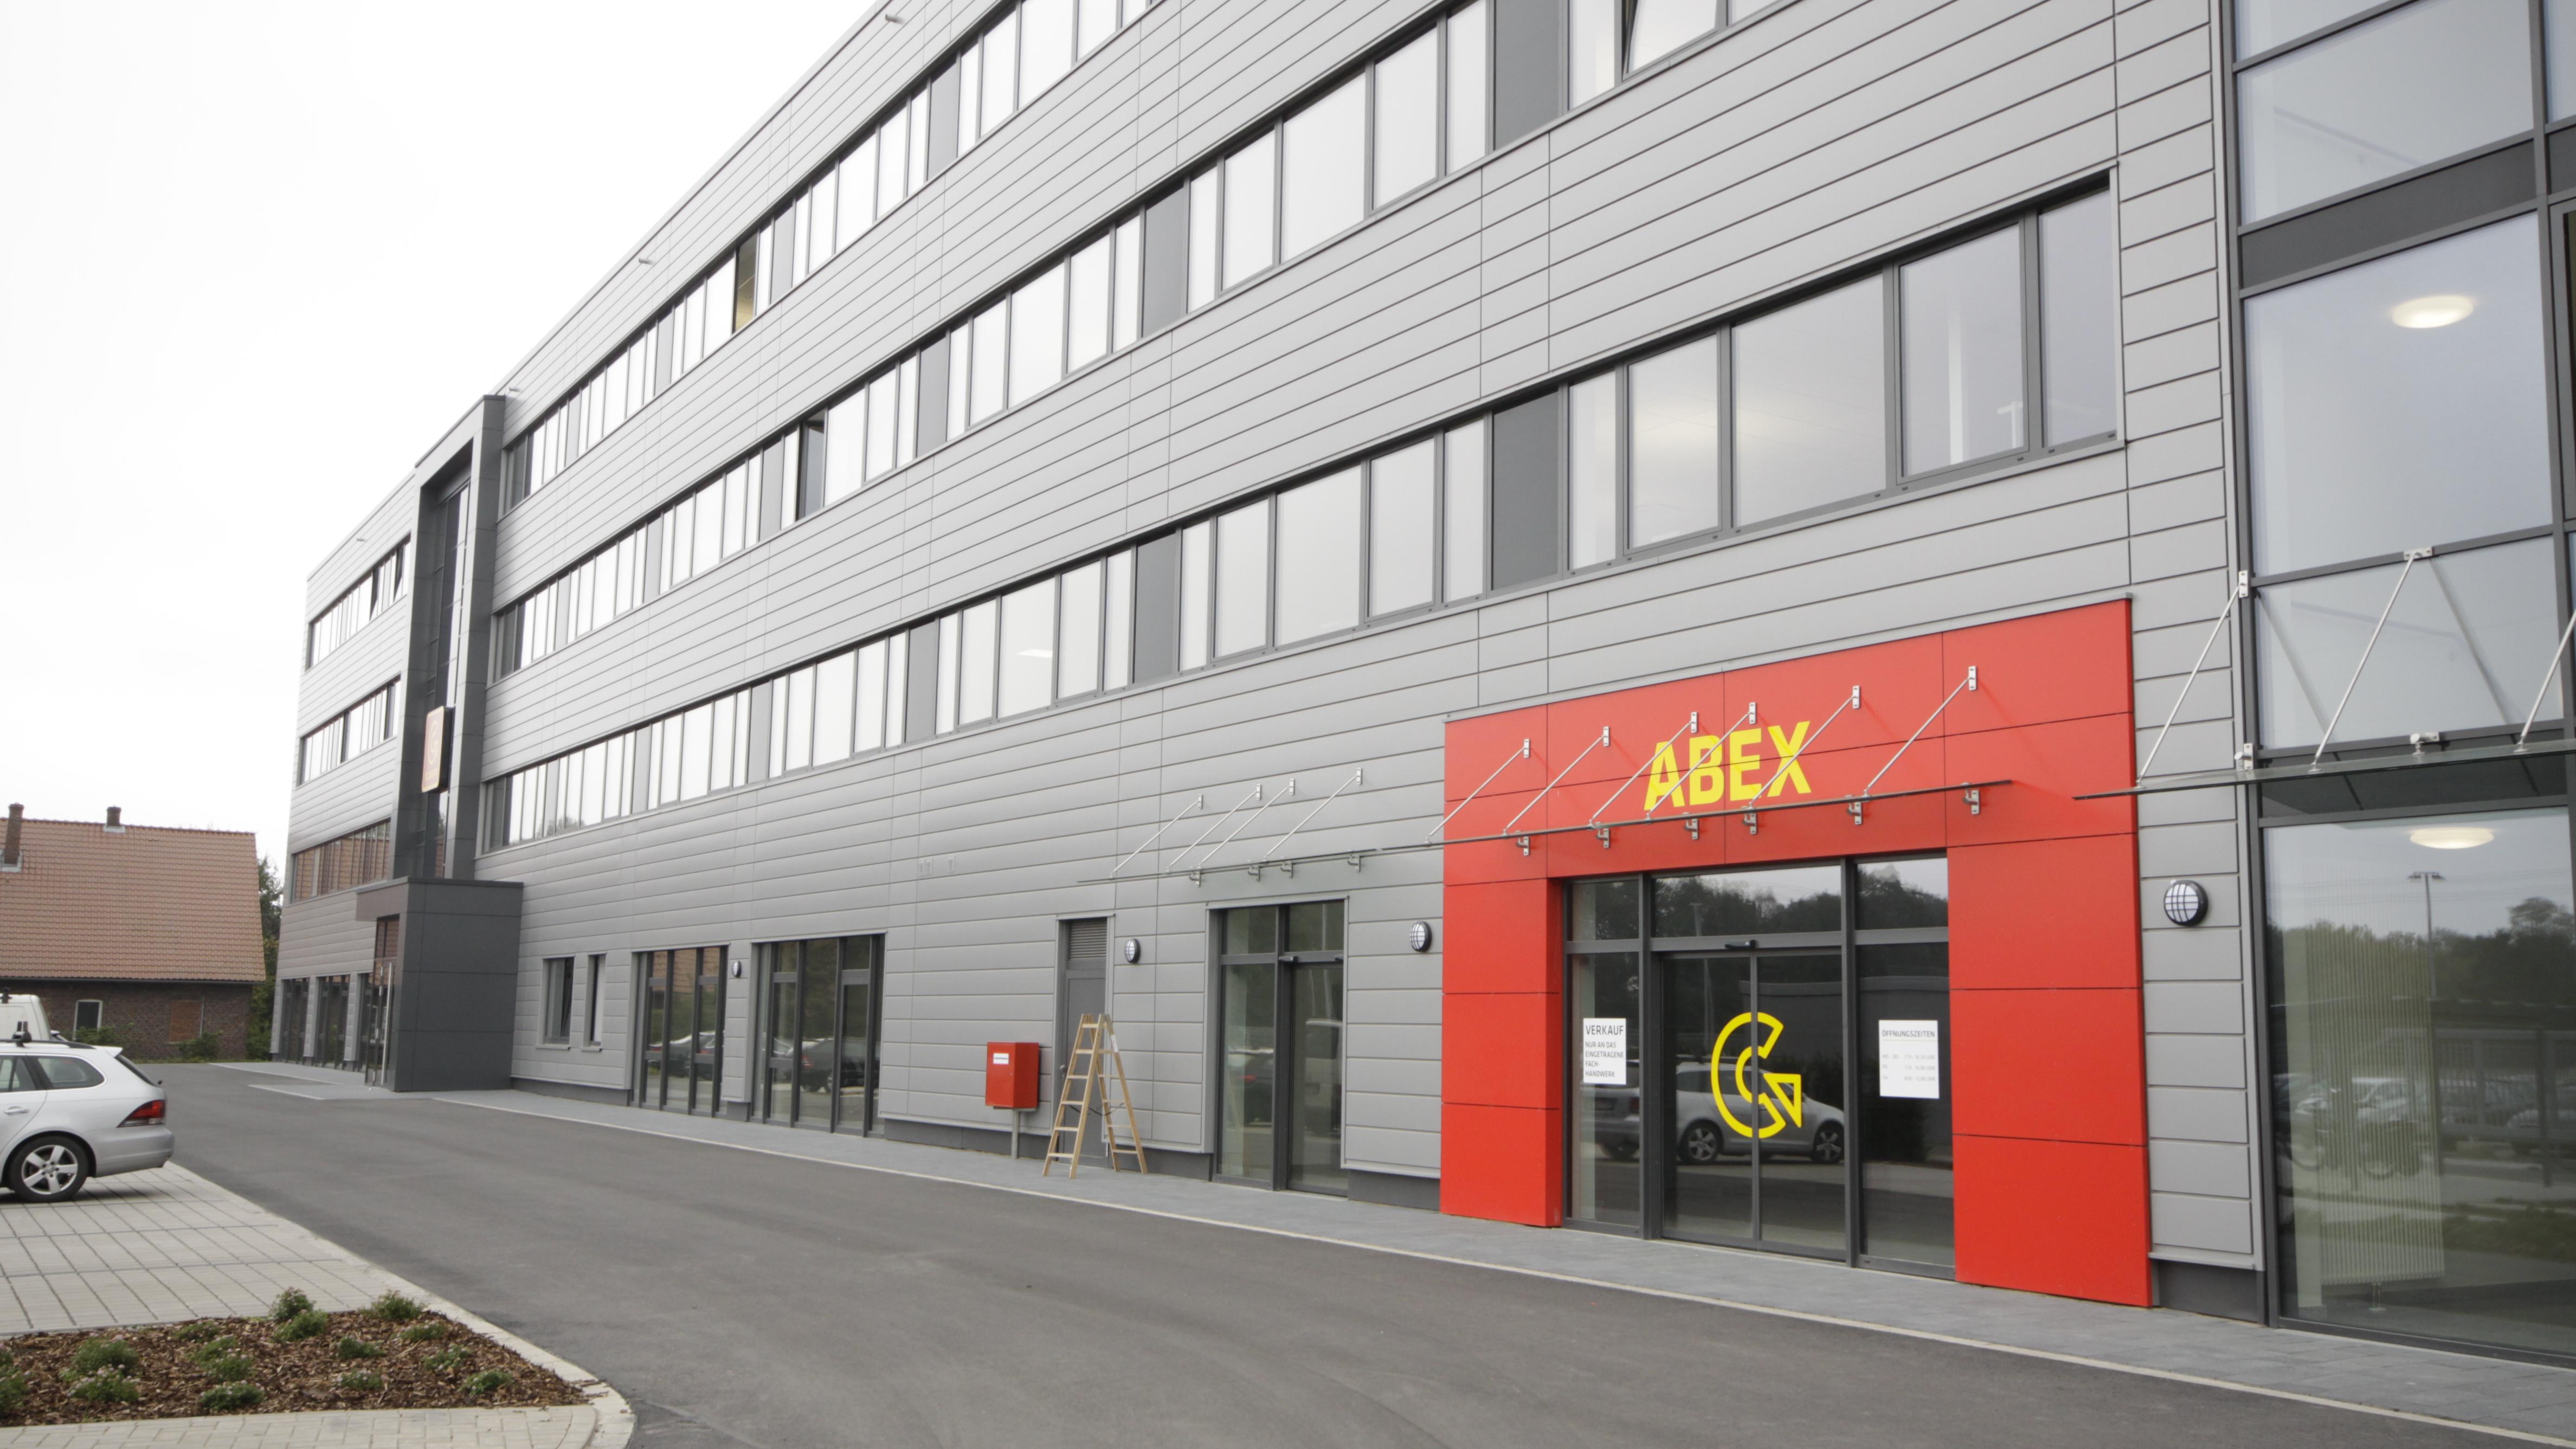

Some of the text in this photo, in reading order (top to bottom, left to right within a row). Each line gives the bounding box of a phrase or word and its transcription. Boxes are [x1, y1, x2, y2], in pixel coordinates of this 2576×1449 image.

[1644, 720, 1812, 811] ABEX
[1586, 1025, 1624, 1035] VERKAUF
[1882, 1029, 1935, 1037] ÖFFNUNGSZEITEN
